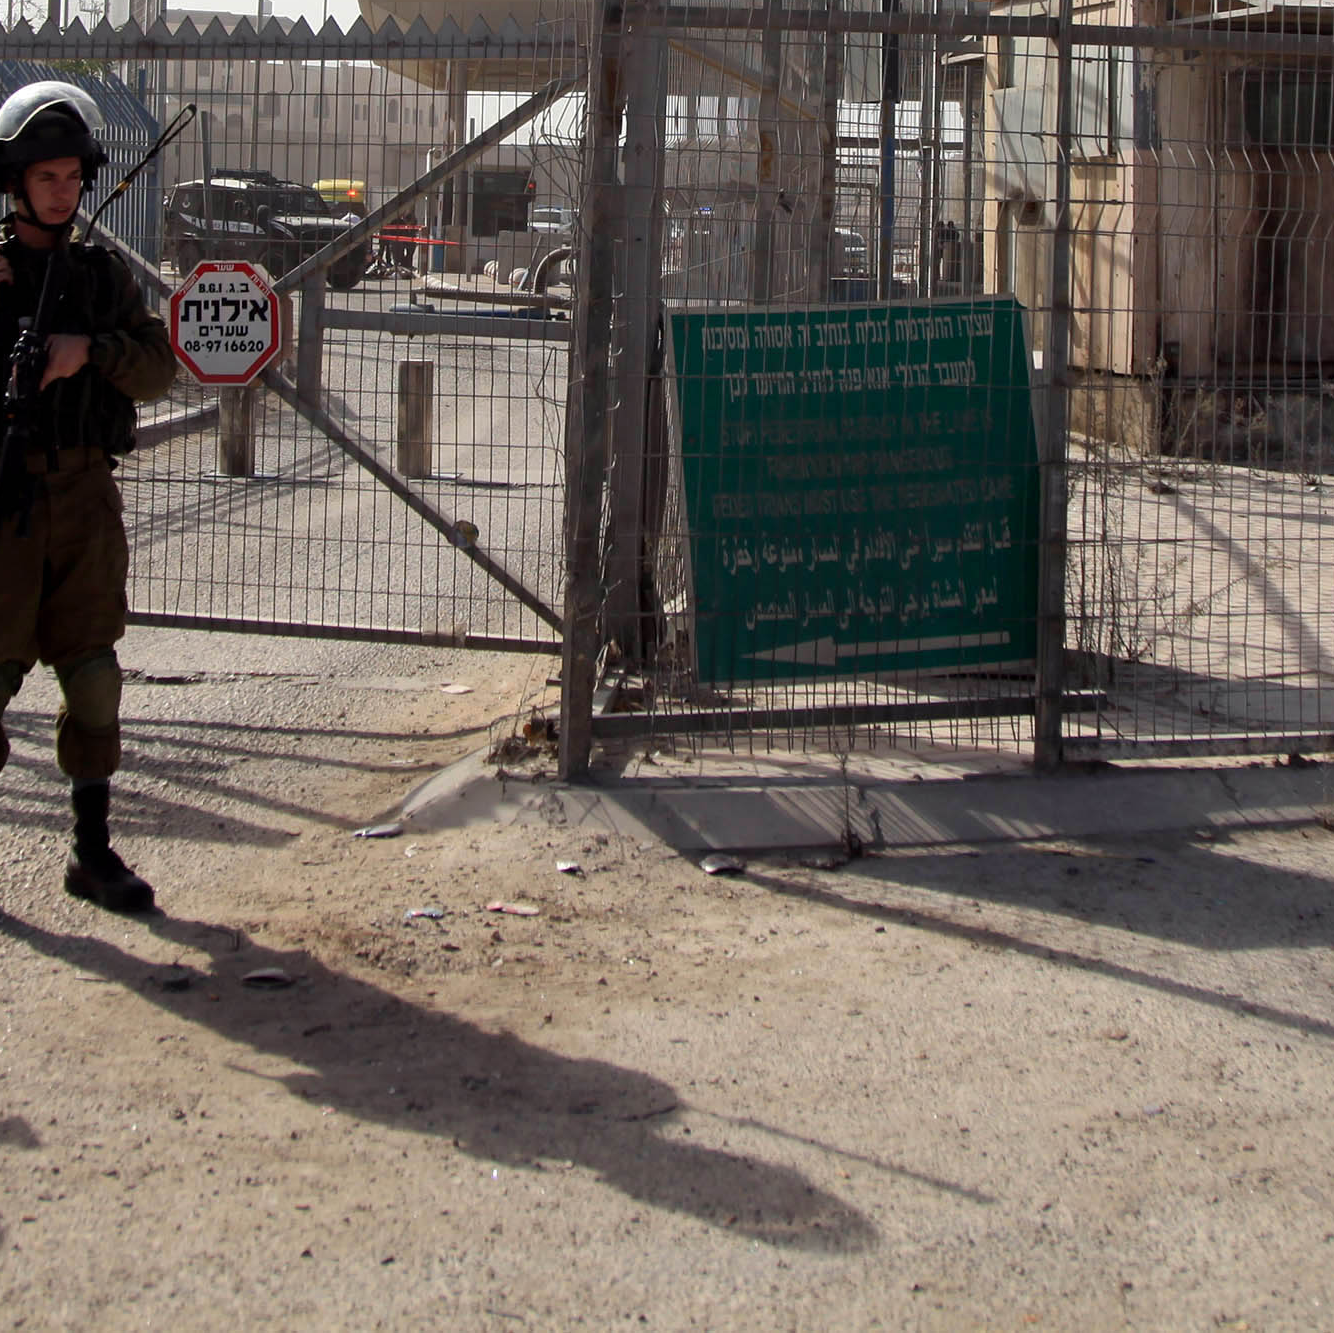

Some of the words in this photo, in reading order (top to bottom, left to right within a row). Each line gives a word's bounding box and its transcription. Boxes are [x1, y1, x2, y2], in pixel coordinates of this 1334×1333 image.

[214, 264, 234, 272] שער
[180, 297, 268, 322] אילנית
[198, 325, 249, 337] שערים
[754, 325, 794, 348] אסורה
[797, 324, 811, 347] זה
[816, 322, 851, 346] בנתיב
[855, 320, 889, 344] רגלית
[895, 315, 953, 341] התקדמות
[957, 313, 994, 337] עצור!
[184, 340, 264, 352] 08-9716620
[895, 362, 930, 388] הרגלי
[934, 356, 977, 386] למעבר
